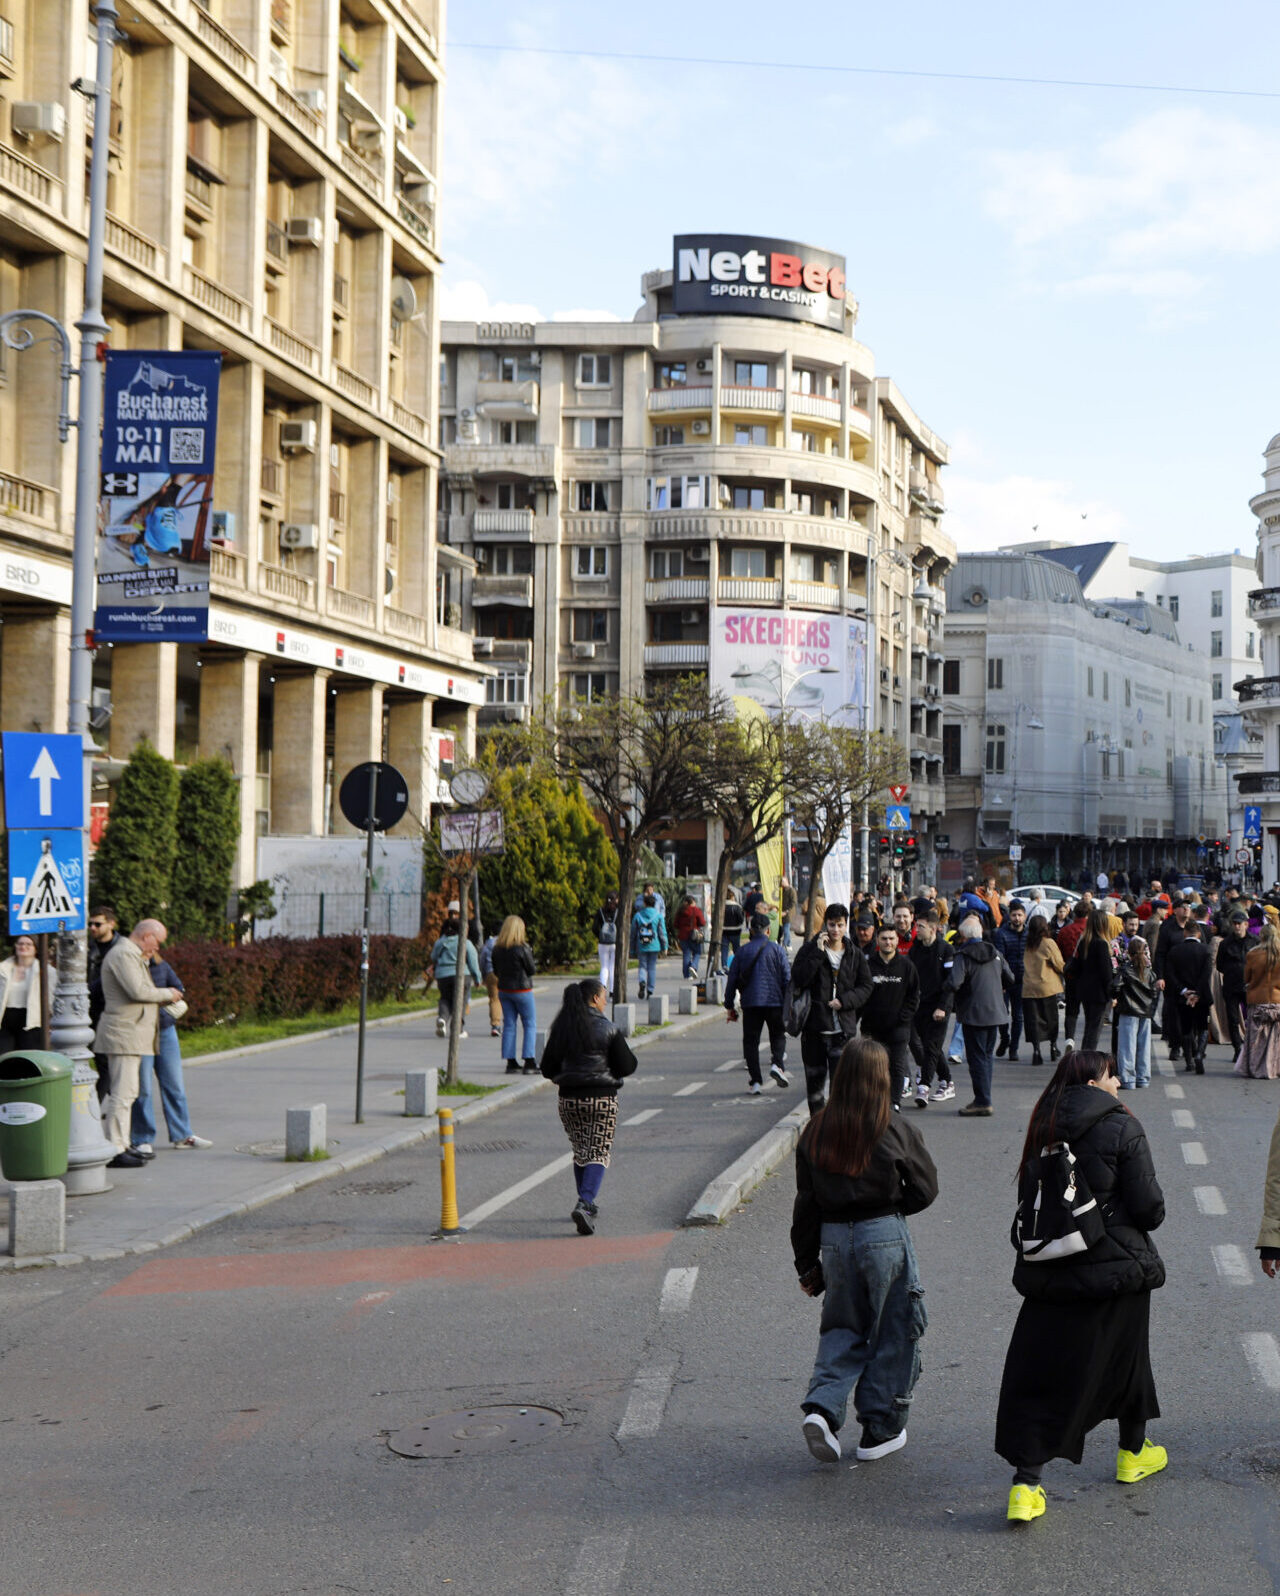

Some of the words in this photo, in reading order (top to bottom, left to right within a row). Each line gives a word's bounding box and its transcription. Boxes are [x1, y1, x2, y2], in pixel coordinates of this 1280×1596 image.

[678, 248, 846, 300] NetBet
[710, 284, 757, 298] SPORT
[117, 390, 208, 411] Bucharest
[117, 408, 145, 420] HALF
[146, 408, 208, 421] MARATHON
[116, 426, 162, 443] 10-11
[115, 444, 161, 463] MAI
[6, 564, 40, 585] BRD
[125, 582, 209, 598] DEPARTE
[214, 619, 238, 636] BRD
[725, 615, 830, 649] SKECHERS
[290, 640, 310, 655] BRD
[791, 651, 830, 666] UNO
